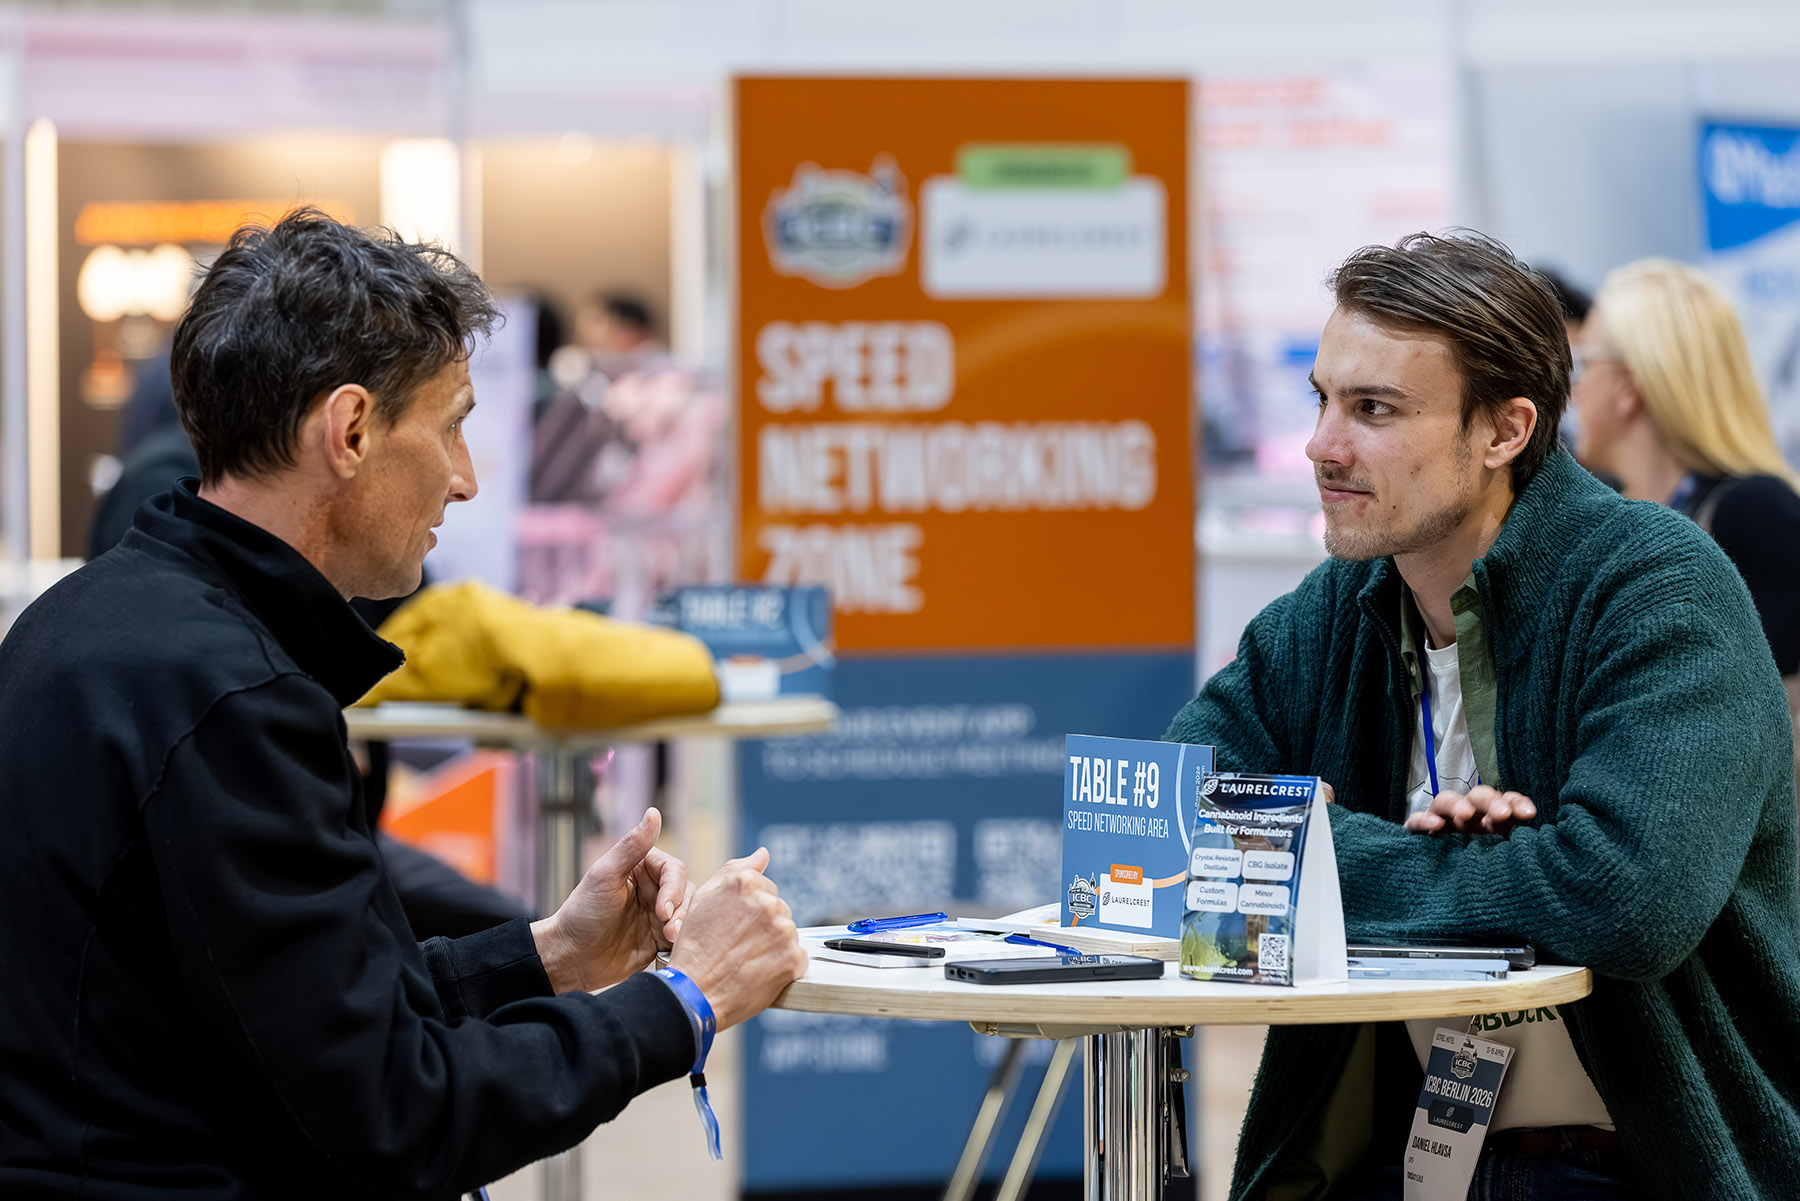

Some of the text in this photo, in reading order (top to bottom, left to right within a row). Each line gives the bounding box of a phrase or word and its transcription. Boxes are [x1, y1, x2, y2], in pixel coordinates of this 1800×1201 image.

[757, 321, 954, 412] SPEED
[758, 421, 1156, 512] NETWORKING
[758, 523, 923, 612] ZONE
[1069, 755, 1160, 809] TABLE #9
[1221, 783, 1311, 797] LAURELCREST
[1198, 808, 1304, 824] Cannabinoid Ingredients
[1067, 810, 1169, 839] SPEED NETWORKING AREA
[1204, 823, 1293, 838] Built for Formulators
[1215, 855, 1240, 863] Resistant
[1247, 861, 1263, 869] CBG
[1199, 886, 1226, 895] Custom
[1255, 889, 1274, 897] Minor
[1072, 893, 1092, 904] ICBC
[1111, 896, 1150, 907] LAURELCREST
[1196, 897, 1228, 907] Formulas
[1240, 900, 1286, 910] Cannabinoids
[1455, 1058, 1473, 1069] ICBC
[1424, 1074, 1494, 1108] ICBC BERLIN 2026
[1411, 1135, 1431, 1153] DANIEL
